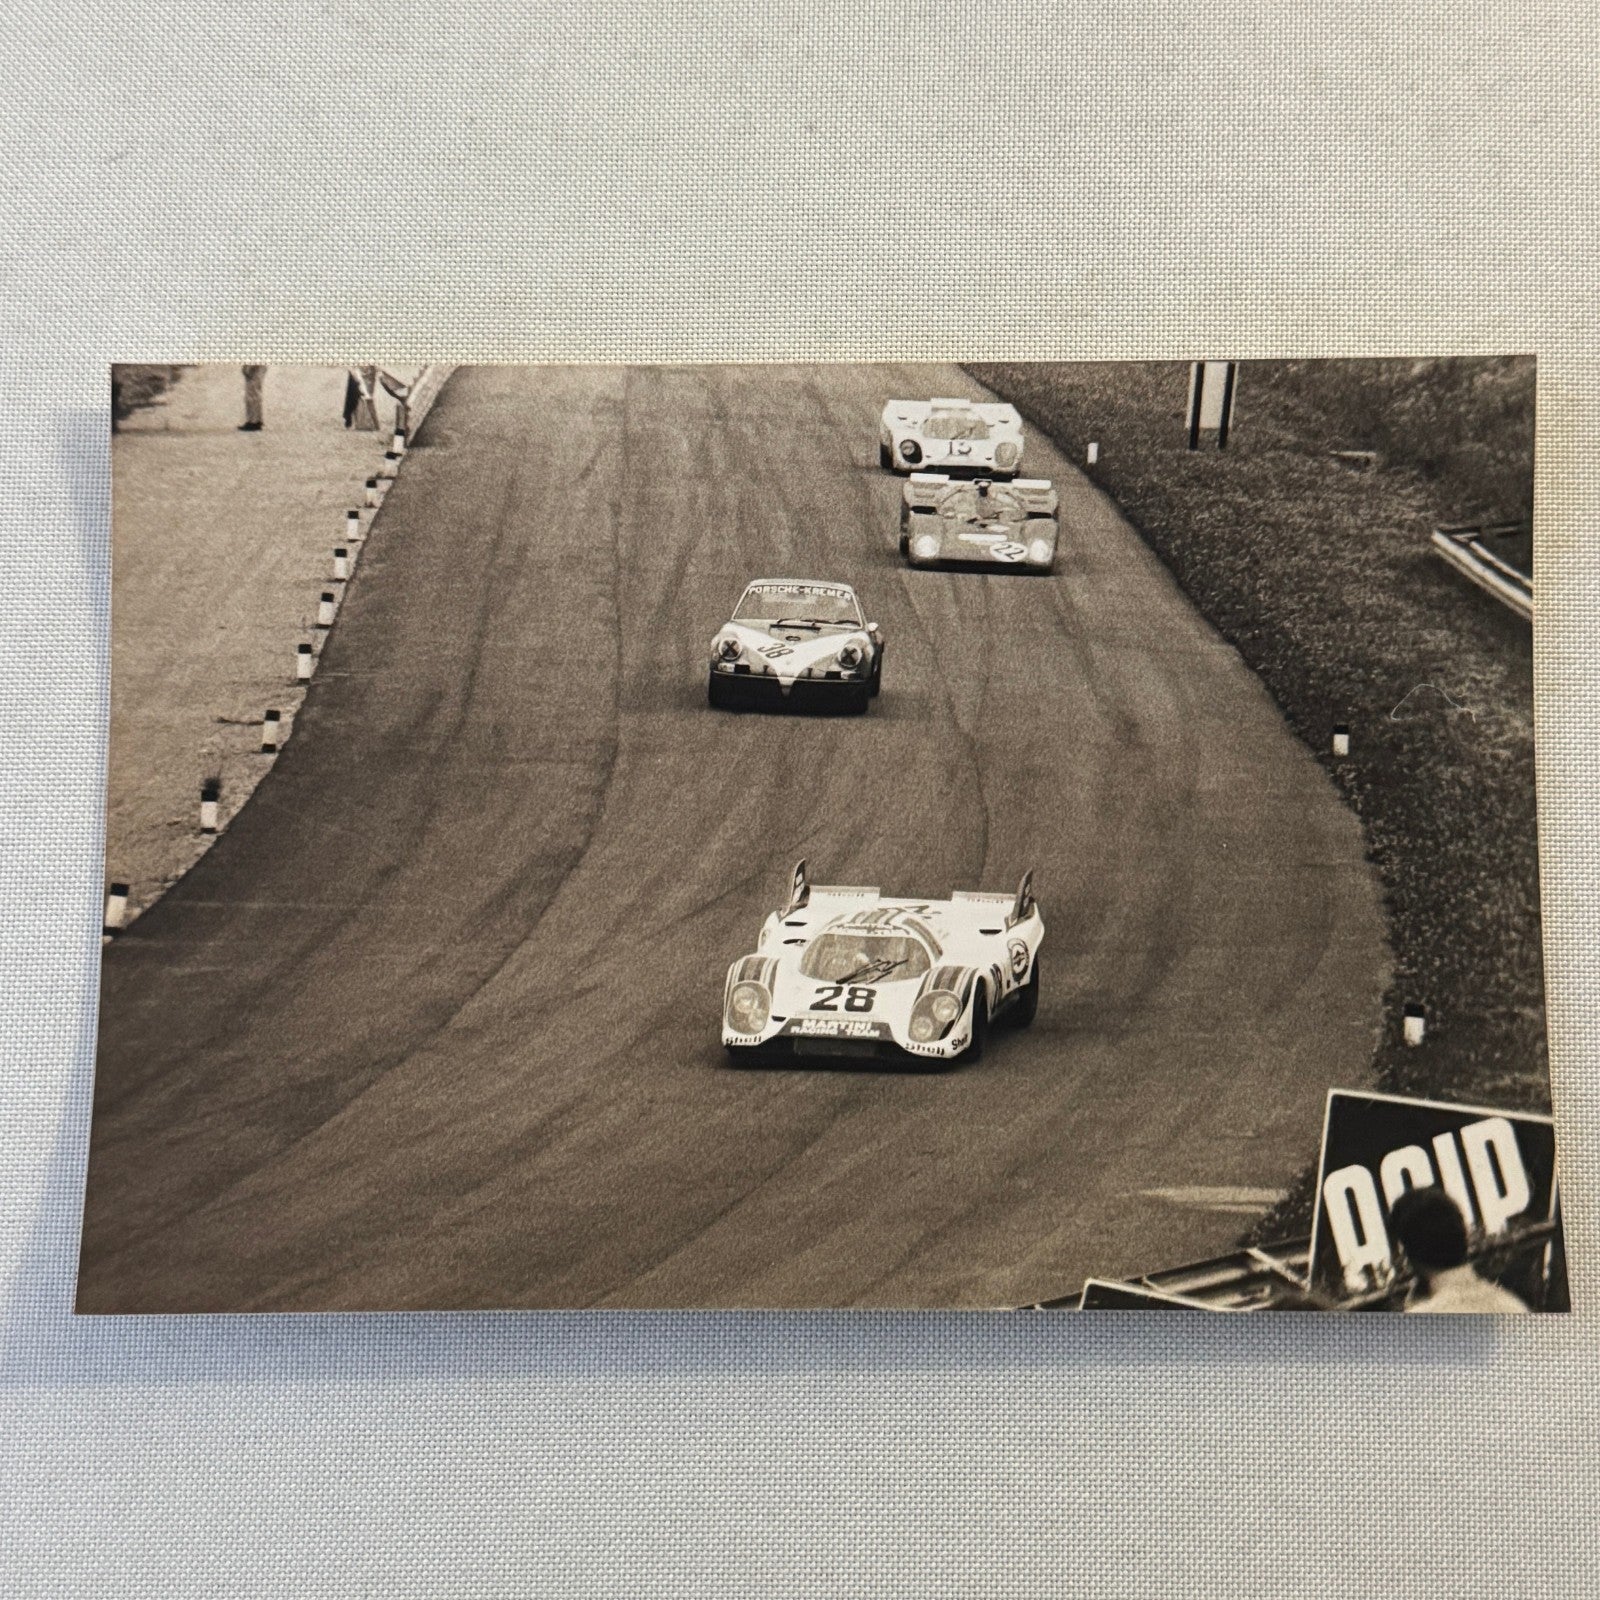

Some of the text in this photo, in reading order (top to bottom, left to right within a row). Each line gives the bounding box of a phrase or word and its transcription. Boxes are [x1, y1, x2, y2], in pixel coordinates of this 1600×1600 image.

[993, 543, 1025, 561] 22
[808, 985, 878, 1013] 28
[790, 1026, 881, 1038] RACING TEAM
[802, 1018, 872, 1031] MARTINI
